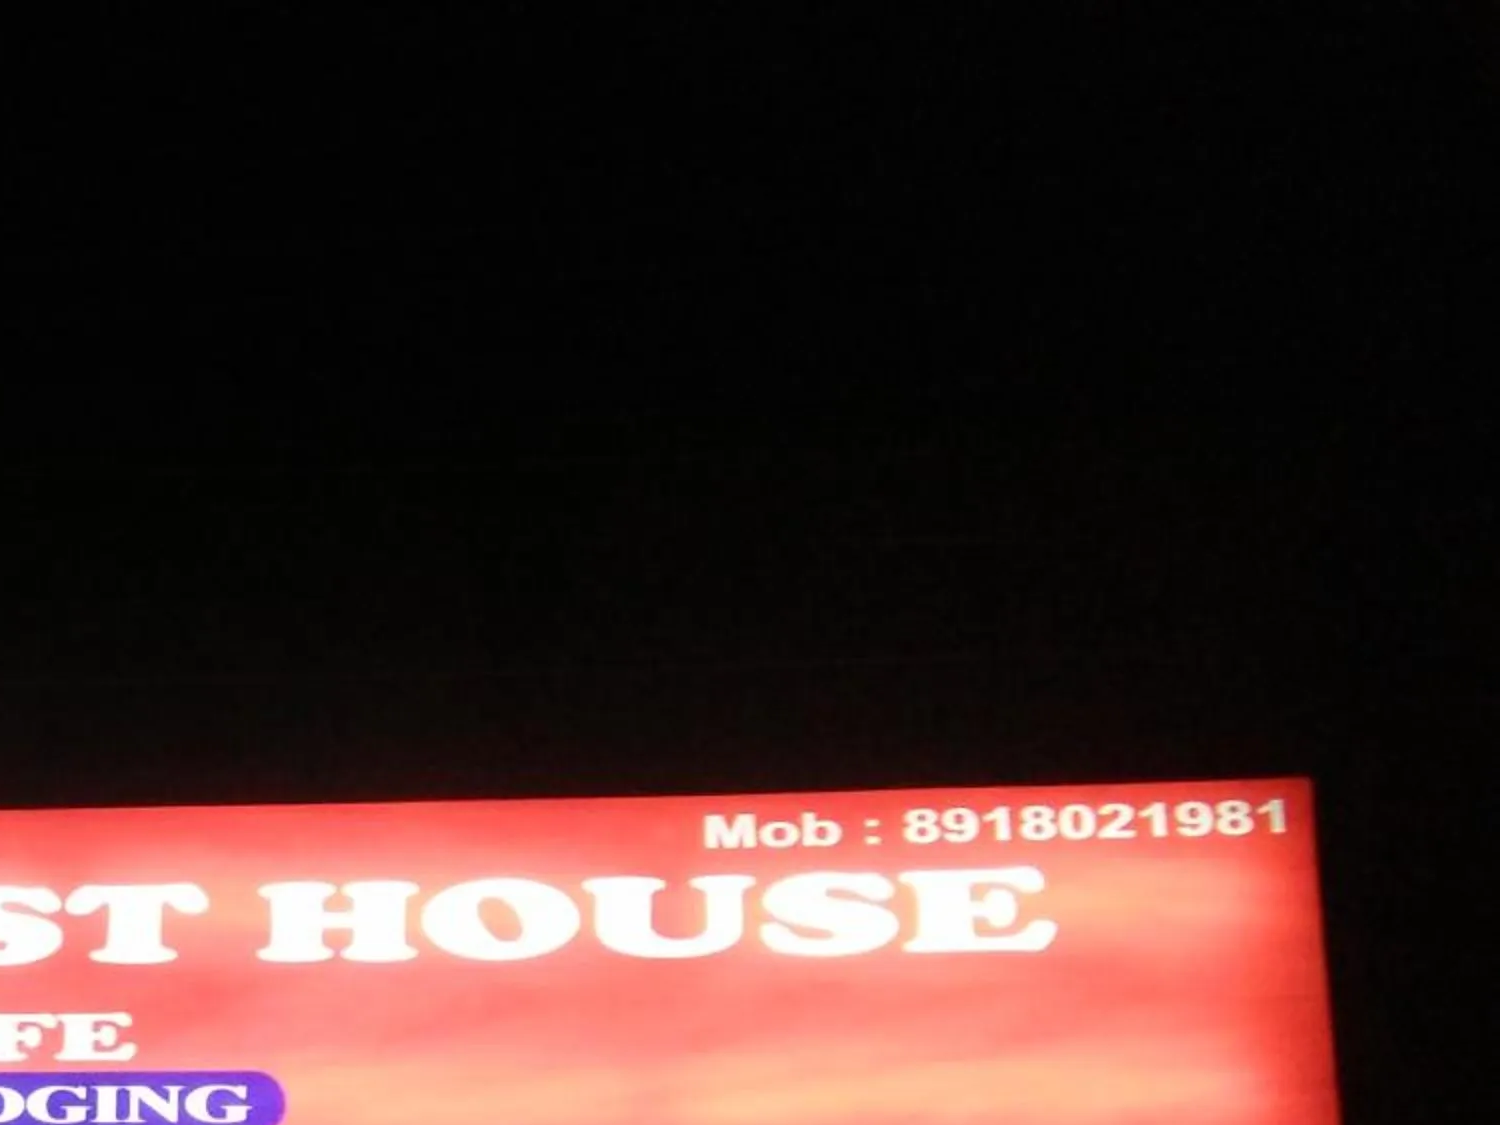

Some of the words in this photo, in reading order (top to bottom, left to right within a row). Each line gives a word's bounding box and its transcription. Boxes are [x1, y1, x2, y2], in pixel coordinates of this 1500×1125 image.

[704, 812, 842, 848] Mob
[903, 799, 1287, 844] 8918021981
[256, 864, 1059, 963] HOUSE
